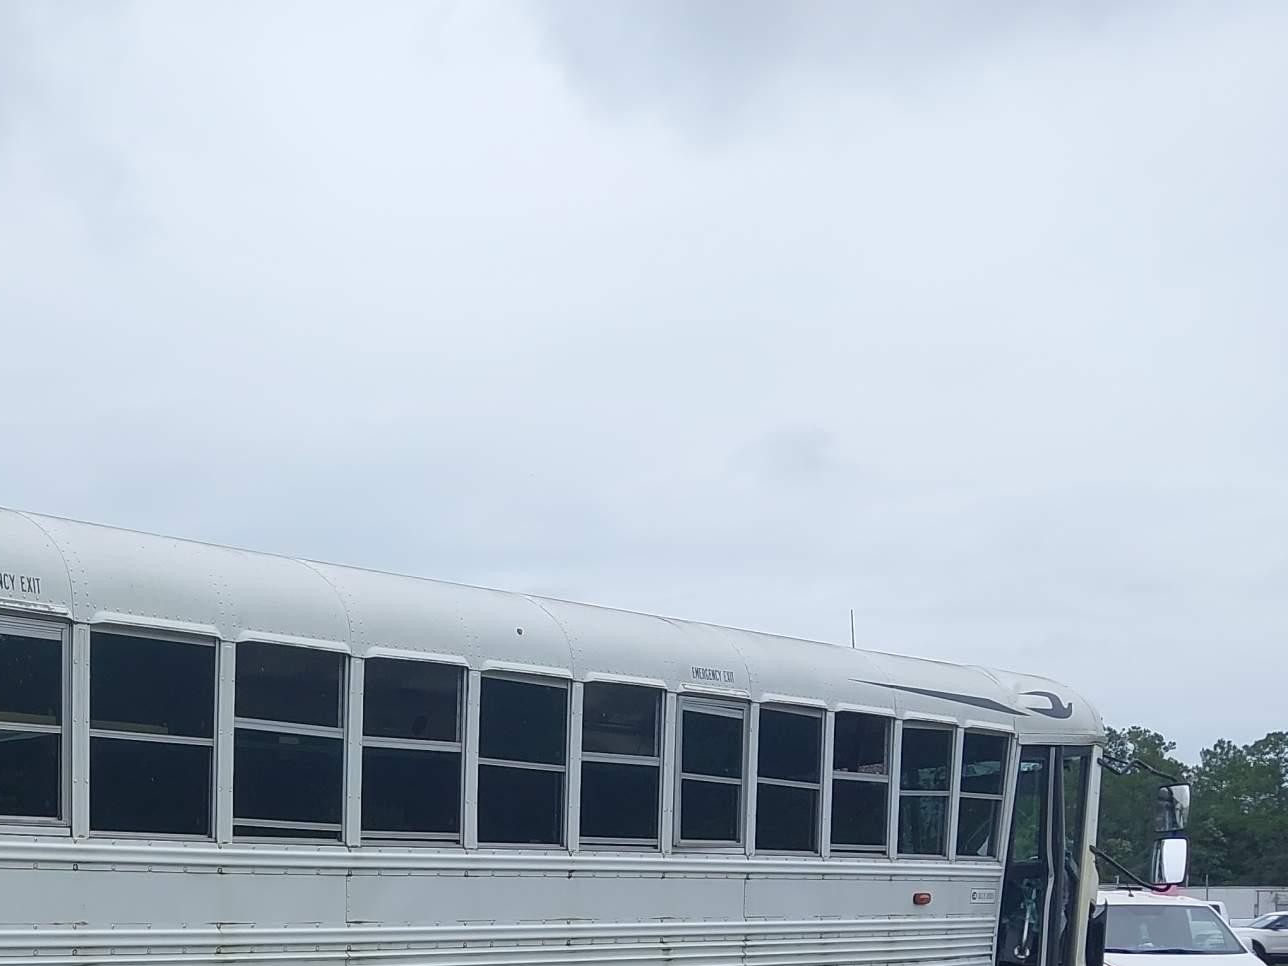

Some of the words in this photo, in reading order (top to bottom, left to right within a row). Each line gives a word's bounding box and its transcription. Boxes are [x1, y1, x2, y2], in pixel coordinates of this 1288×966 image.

[19, 575, 41, 595] EXIT
[691, 666, 721, 682] EMERGENCY
[722, 670, 734, 683] EXIT
